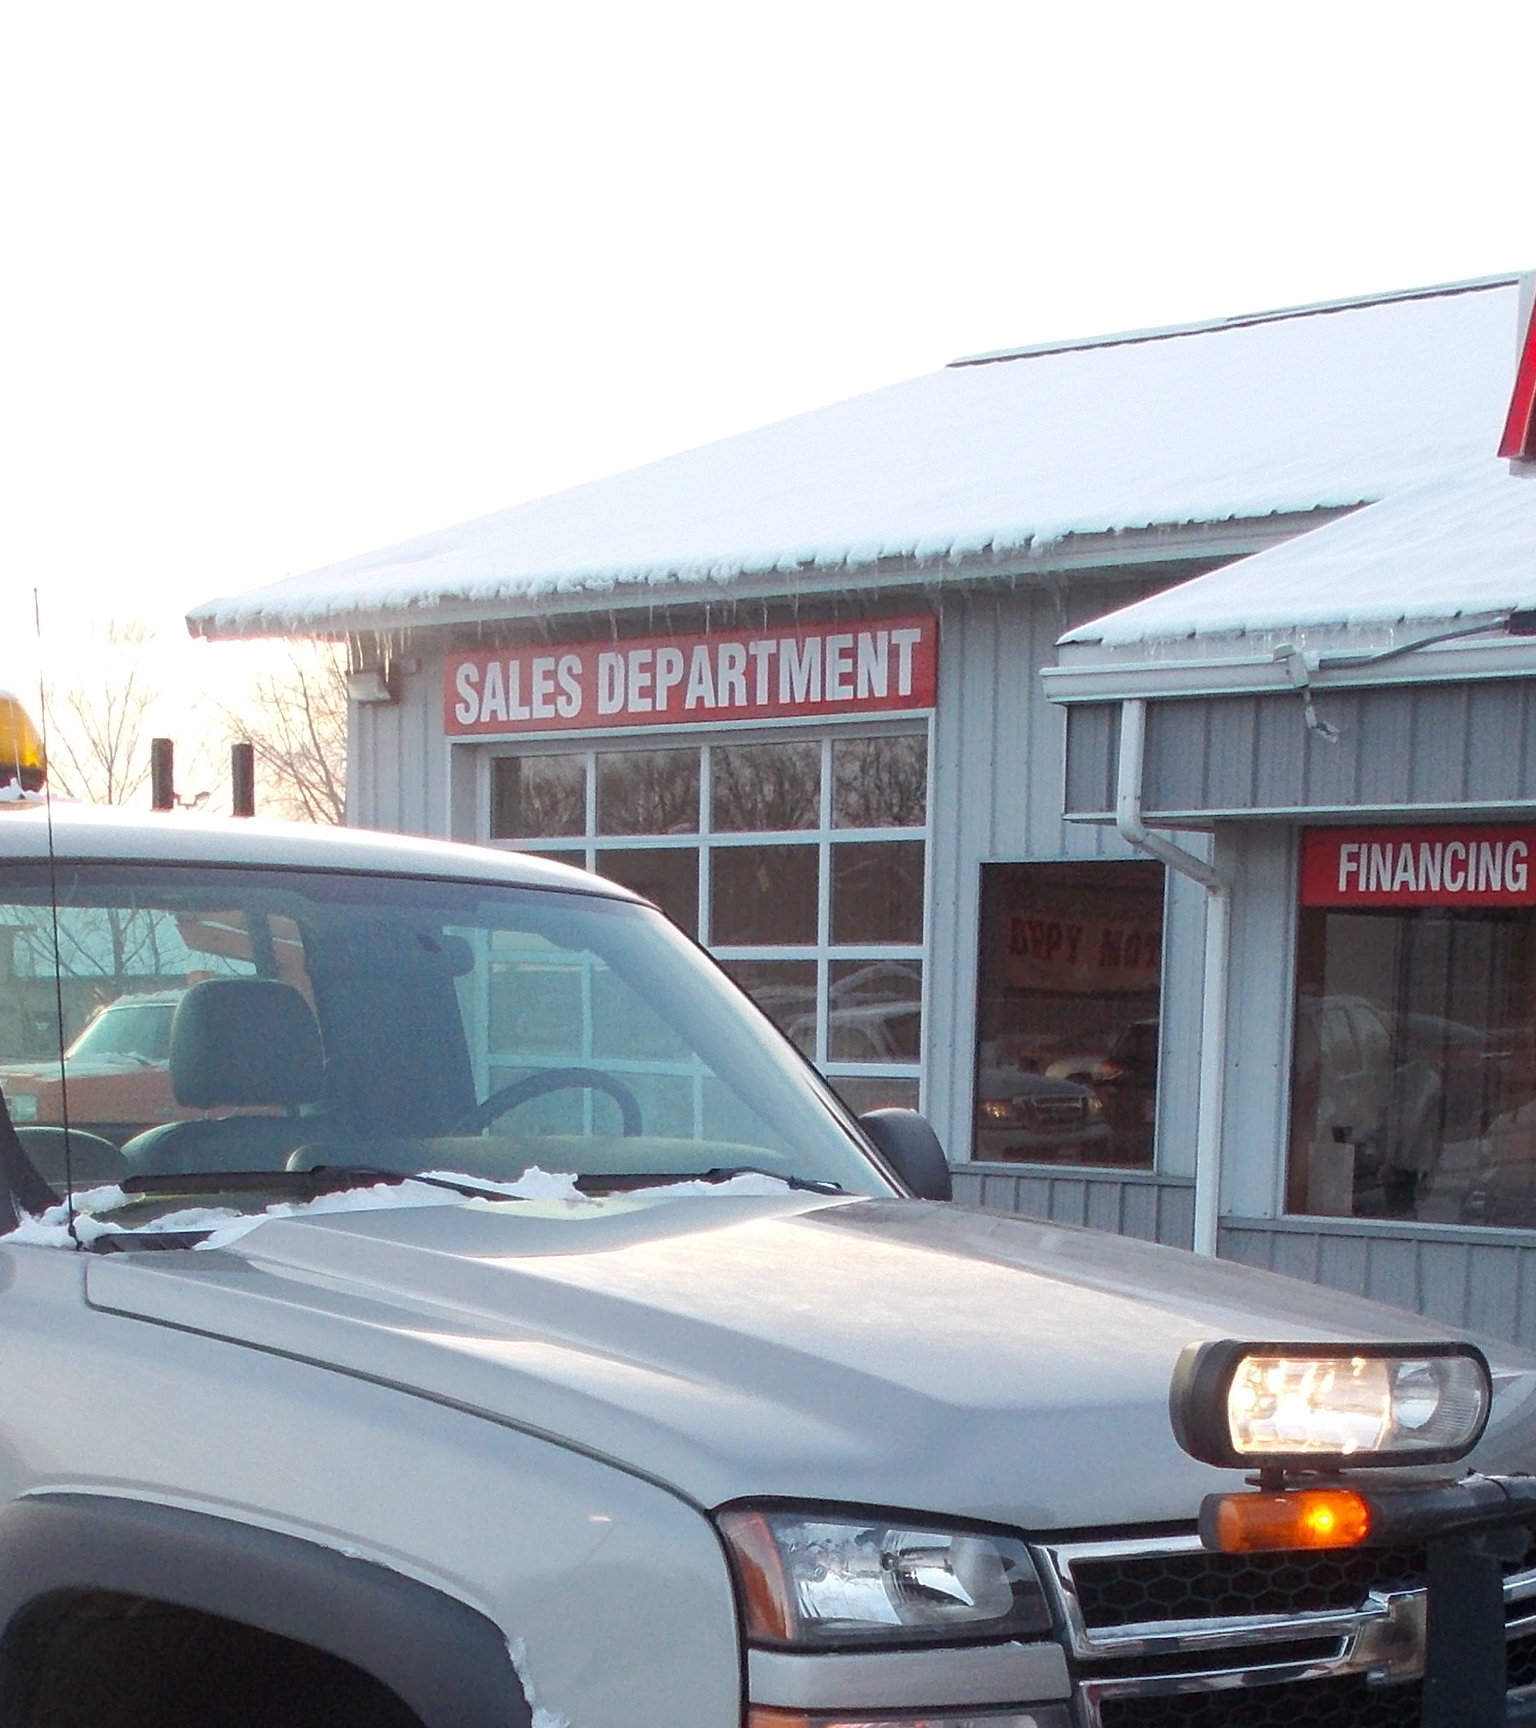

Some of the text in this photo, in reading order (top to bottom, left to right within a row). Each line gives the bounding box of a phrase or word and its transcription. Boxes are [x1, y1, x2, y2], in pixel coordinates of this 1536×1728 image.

[455, 628, 922, 726] SALES DEPARTMENT
[1338, 840, 1528, 892] FINANCING
